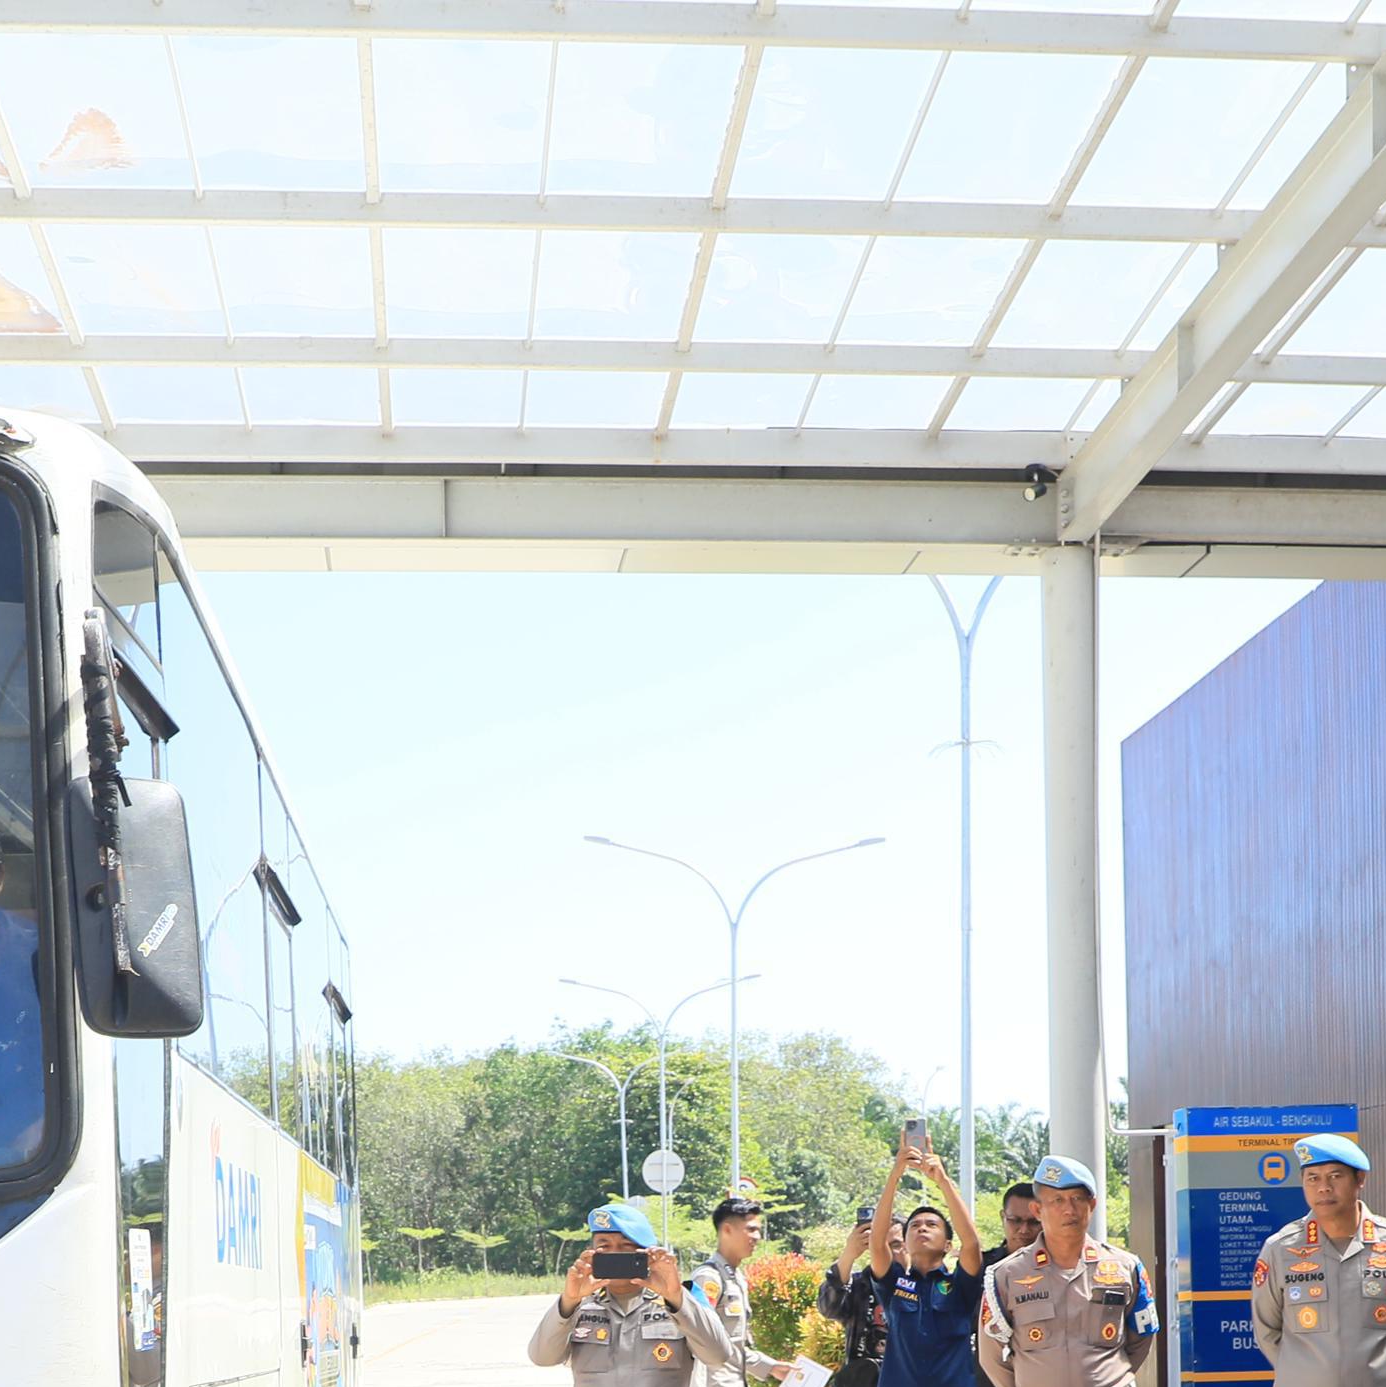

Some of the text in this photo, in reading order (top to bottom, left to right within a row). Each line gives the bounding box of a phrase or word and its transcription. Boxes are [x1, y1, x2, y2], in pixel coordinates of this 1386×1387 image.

[145, 913, 170, 945] DAMRI
[1214, 1117, 1229, 1128] AIR
[1231, 1115, 1274, 1128] SEBAKUL
[1282, 1114, 1332, 1127] BENGKULU
[1238, 1138, 1281, 1147] TERMINAL
[1219, 1192, 1261, 1200] GEDUNG
[1219, 1203, 1269, 1212] TERMINAL
[215, 1156, 263, 1270] DAMRI
[1219, 1215, 1254, 1224] UTAMA
[1285, 1272, 1325, 1283] SUGENG
